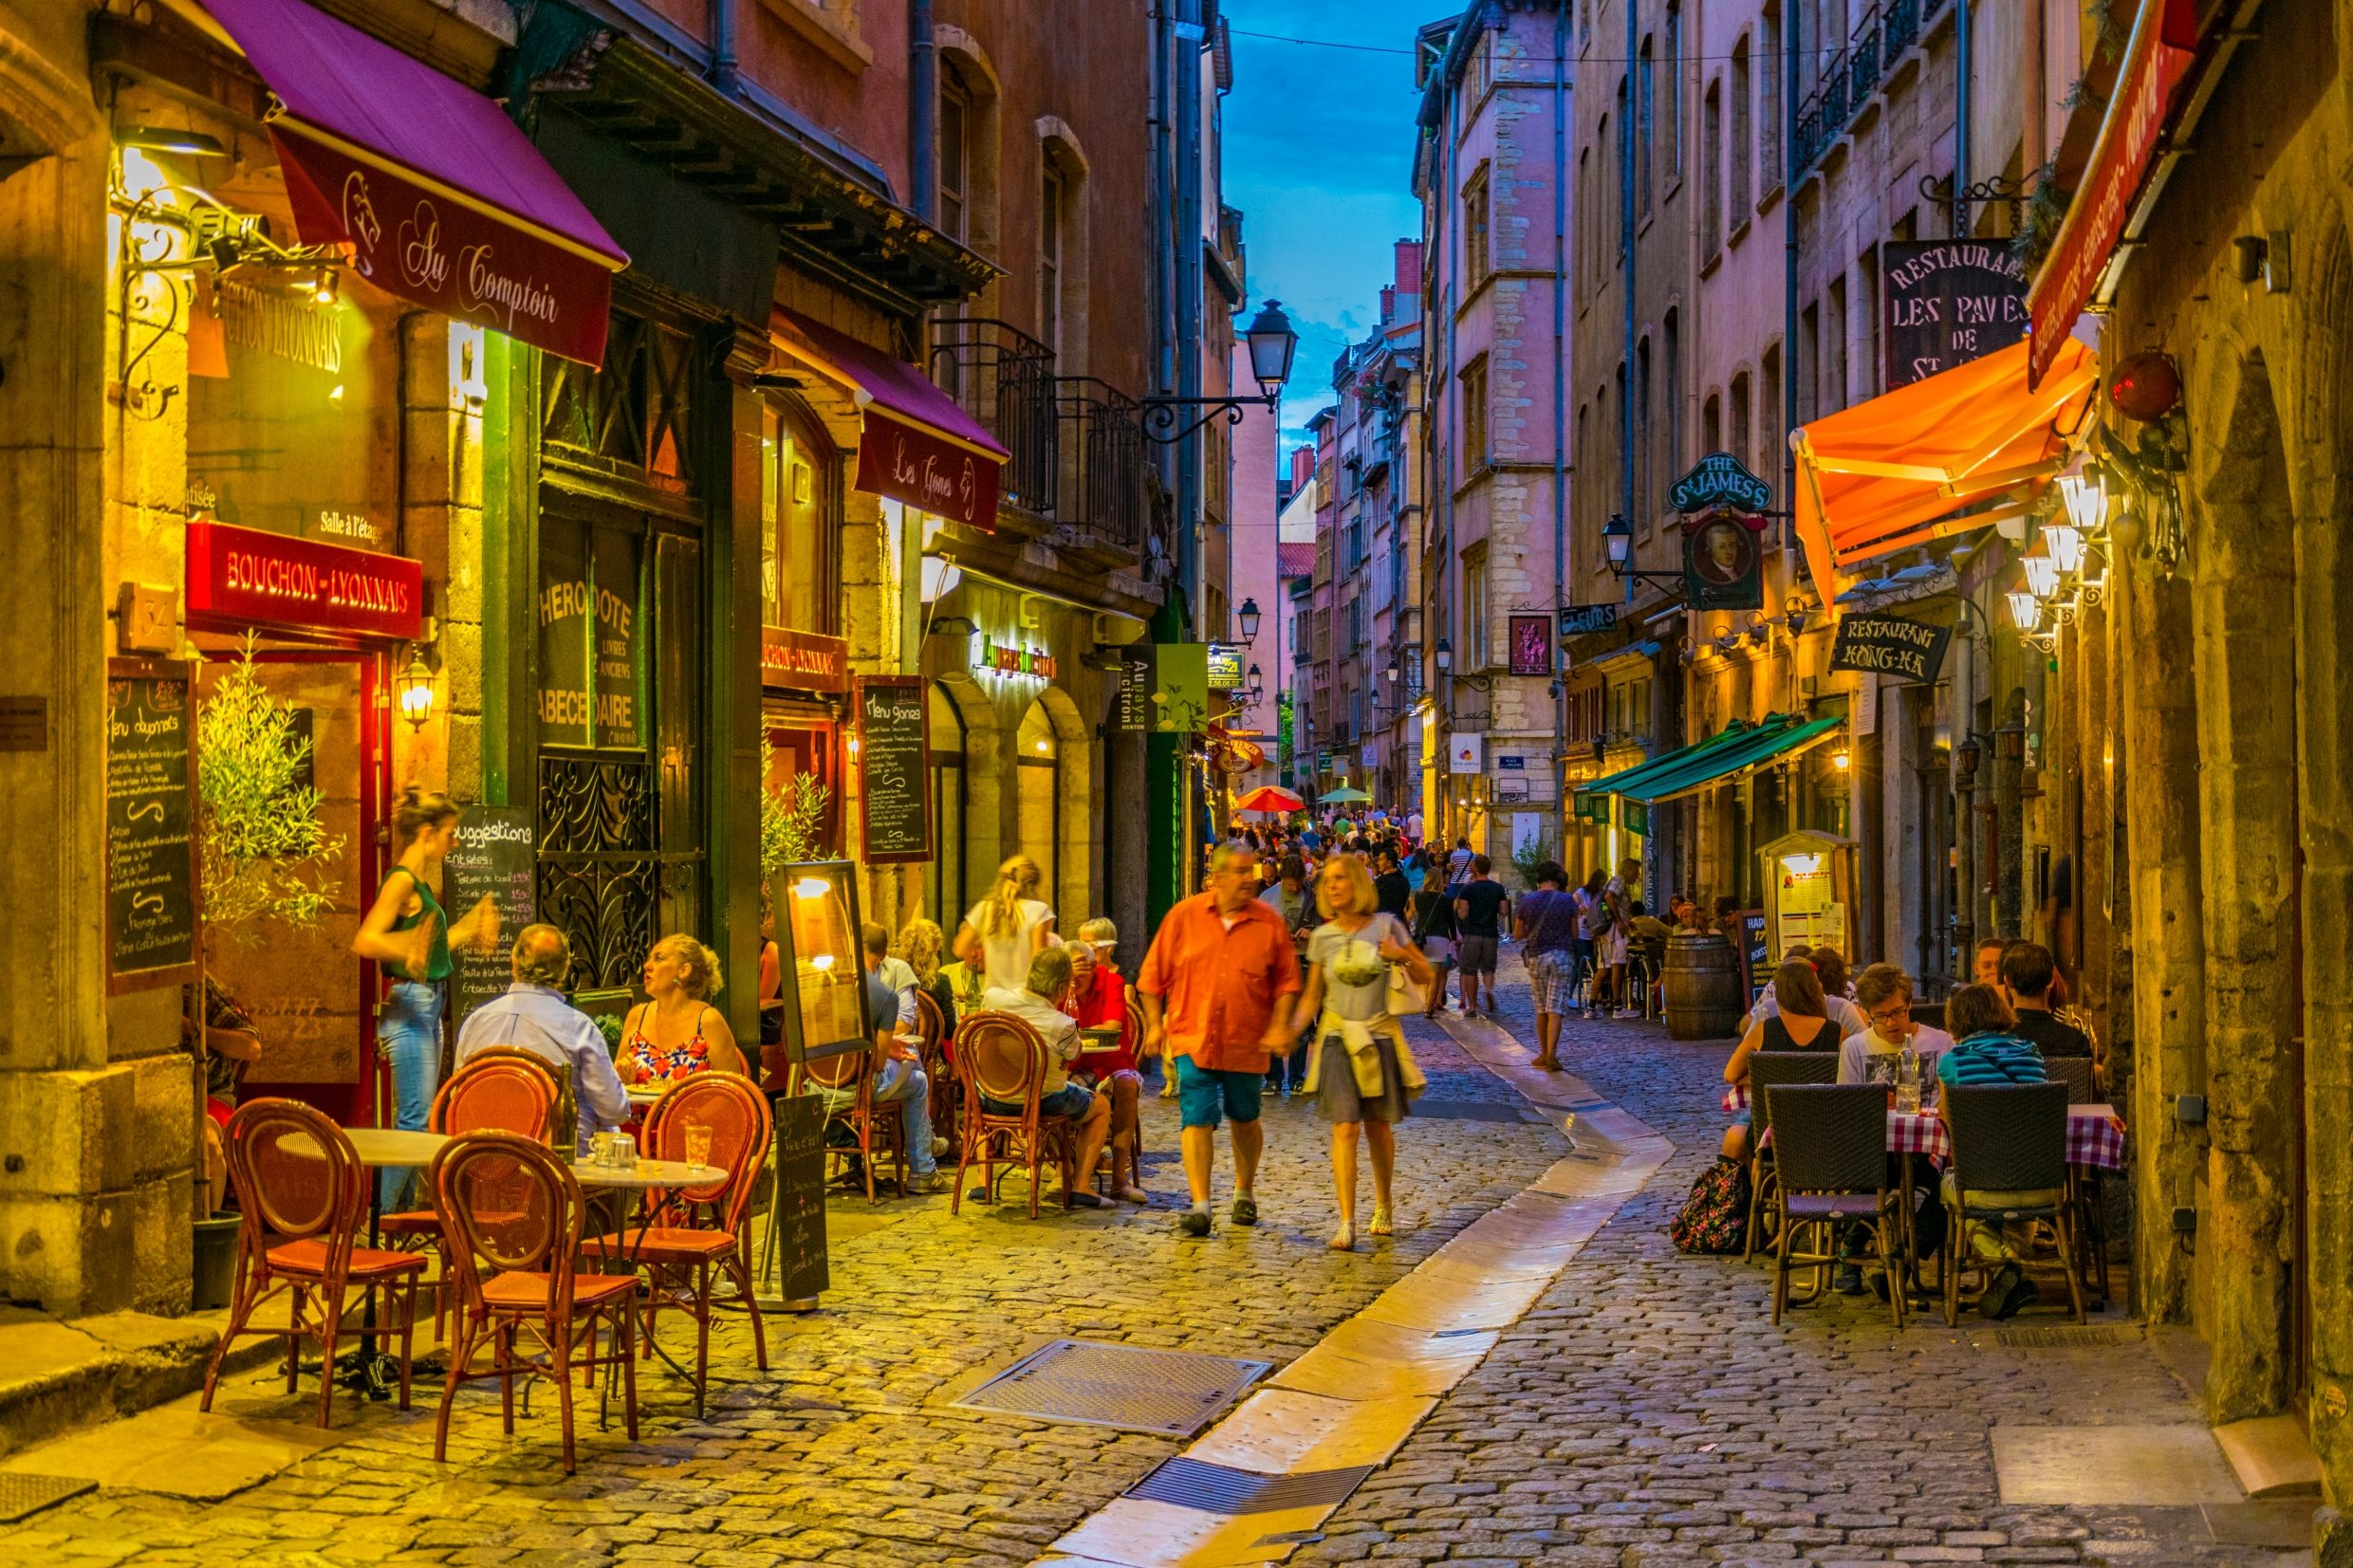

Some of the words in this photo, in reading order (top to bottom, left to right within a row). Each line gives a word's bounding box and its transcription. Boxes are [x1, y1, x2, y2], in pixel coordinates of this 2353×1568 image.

[398, 199, 451, 292] Au
[456, 244, 560, 332] Comptoir
[1890, 245, 2025, 290] RESTAURAN
[1893, 297, 1941, 326] LES
[1952, 328, 1977, 352] DE
[1706, 456, 1734, 471] THE
[320, 510, 344, 534] Salle
[344, 514, 353, 536] à
[1847, 619, 1936, 650] RESTAURANT
[602, 639, 626, 657] LIVRES
[600, 661, 630, 679] ANCIENS
